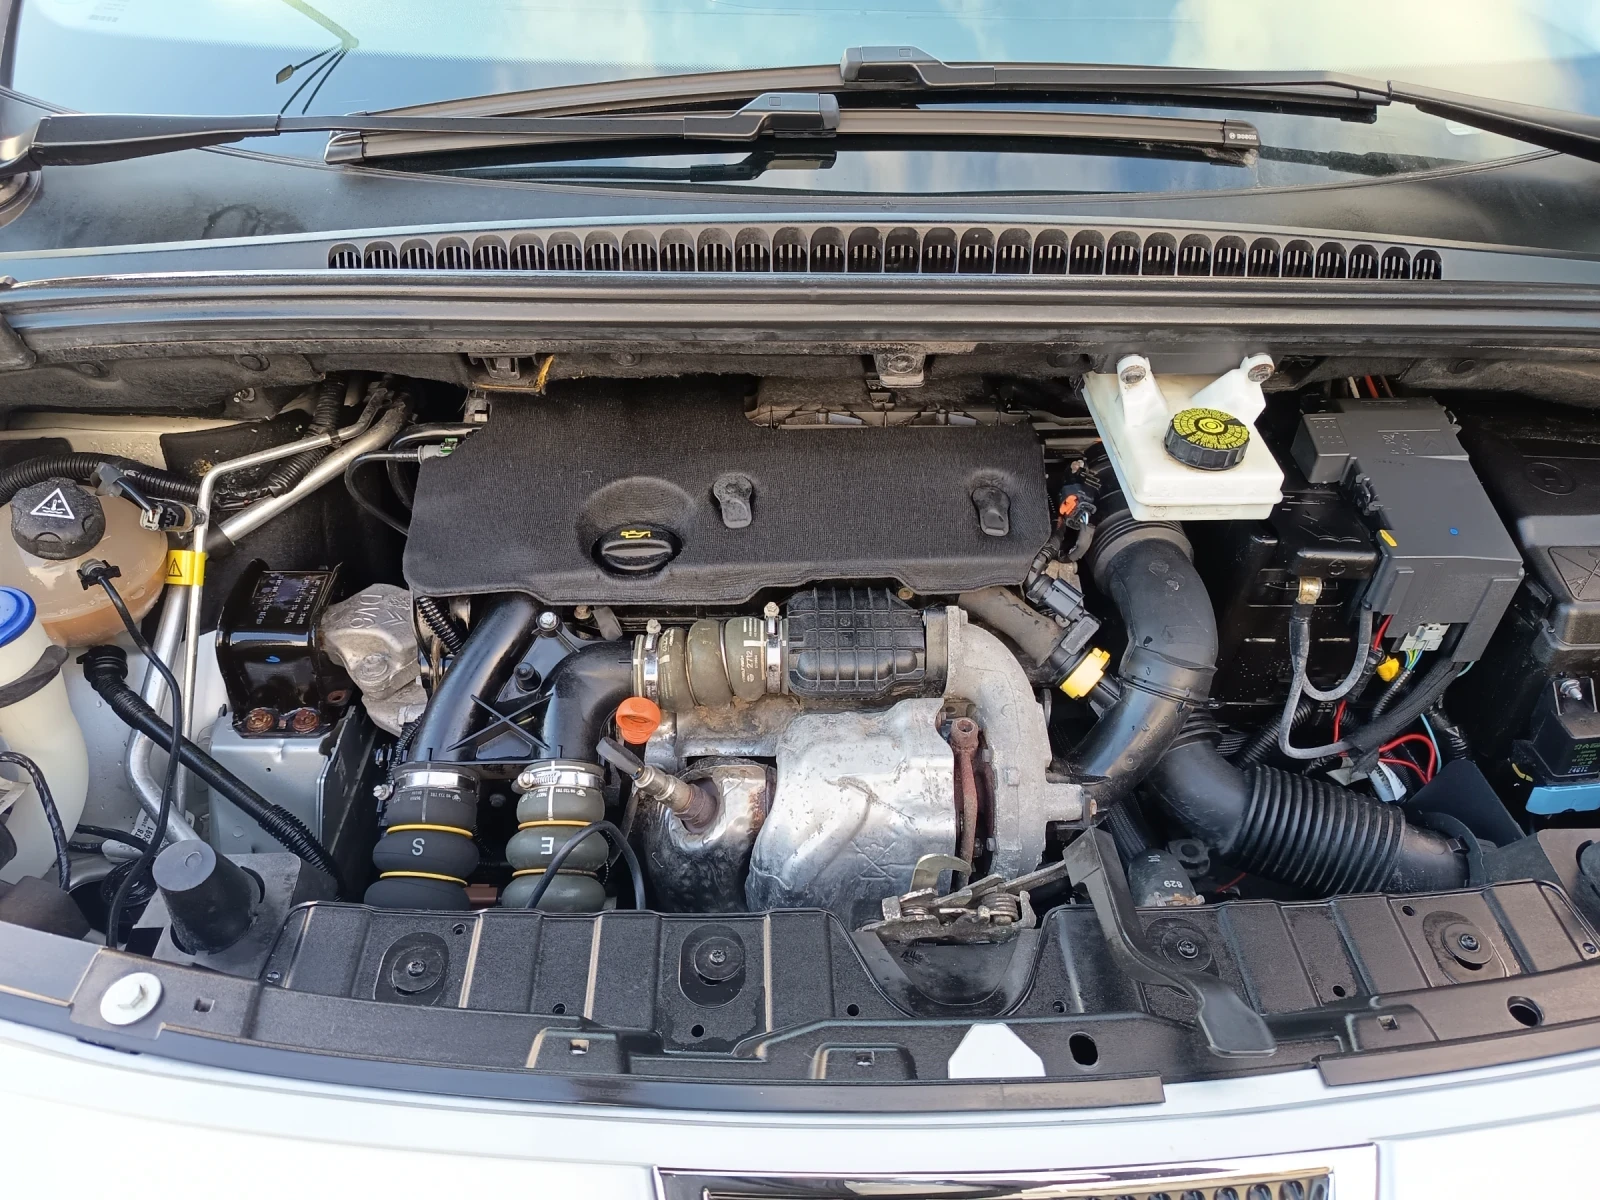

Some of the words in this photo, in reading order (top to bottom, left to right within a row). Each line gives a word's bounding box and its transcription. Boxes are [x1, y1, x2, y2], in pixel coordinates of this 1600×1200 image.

[1236, 133, 1257, 141] BOSCH
[349, 594, 384, 629] DV6
[745, 649, 754, 669] 2712
[411, 837, 425, 857] S
[540, 836, 554, 855] E
[1163, 880, 1184, 889] 829
